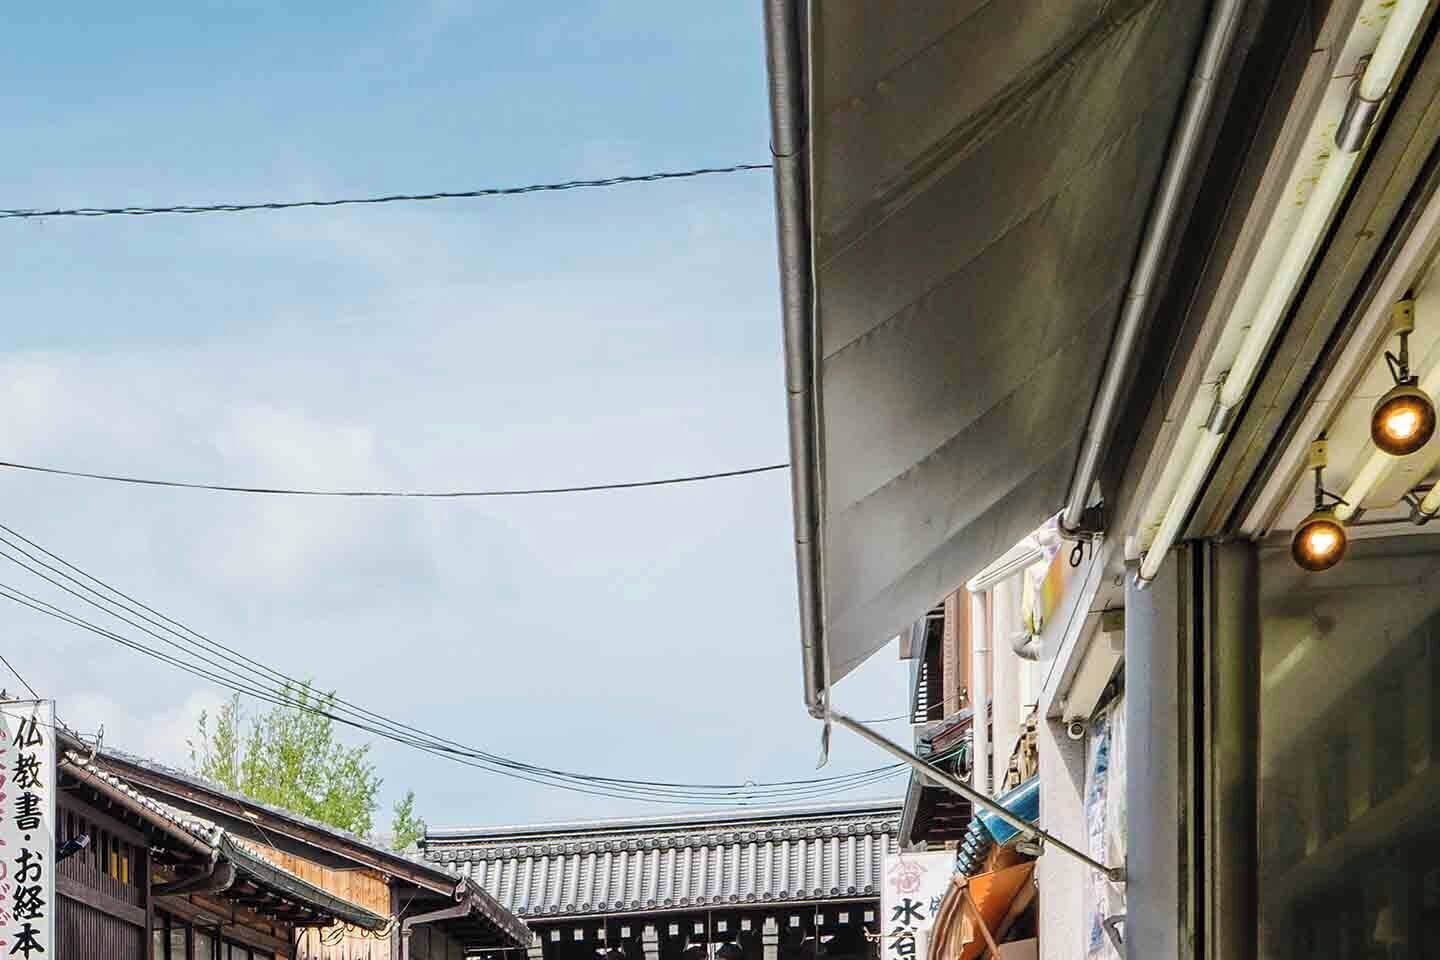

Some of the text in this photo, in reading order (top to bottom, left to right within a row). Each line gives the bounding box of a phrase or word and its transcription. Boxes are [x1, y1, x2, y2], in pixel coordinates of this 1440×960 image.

[9, 715, 45, 960] 仏教書・お経本
